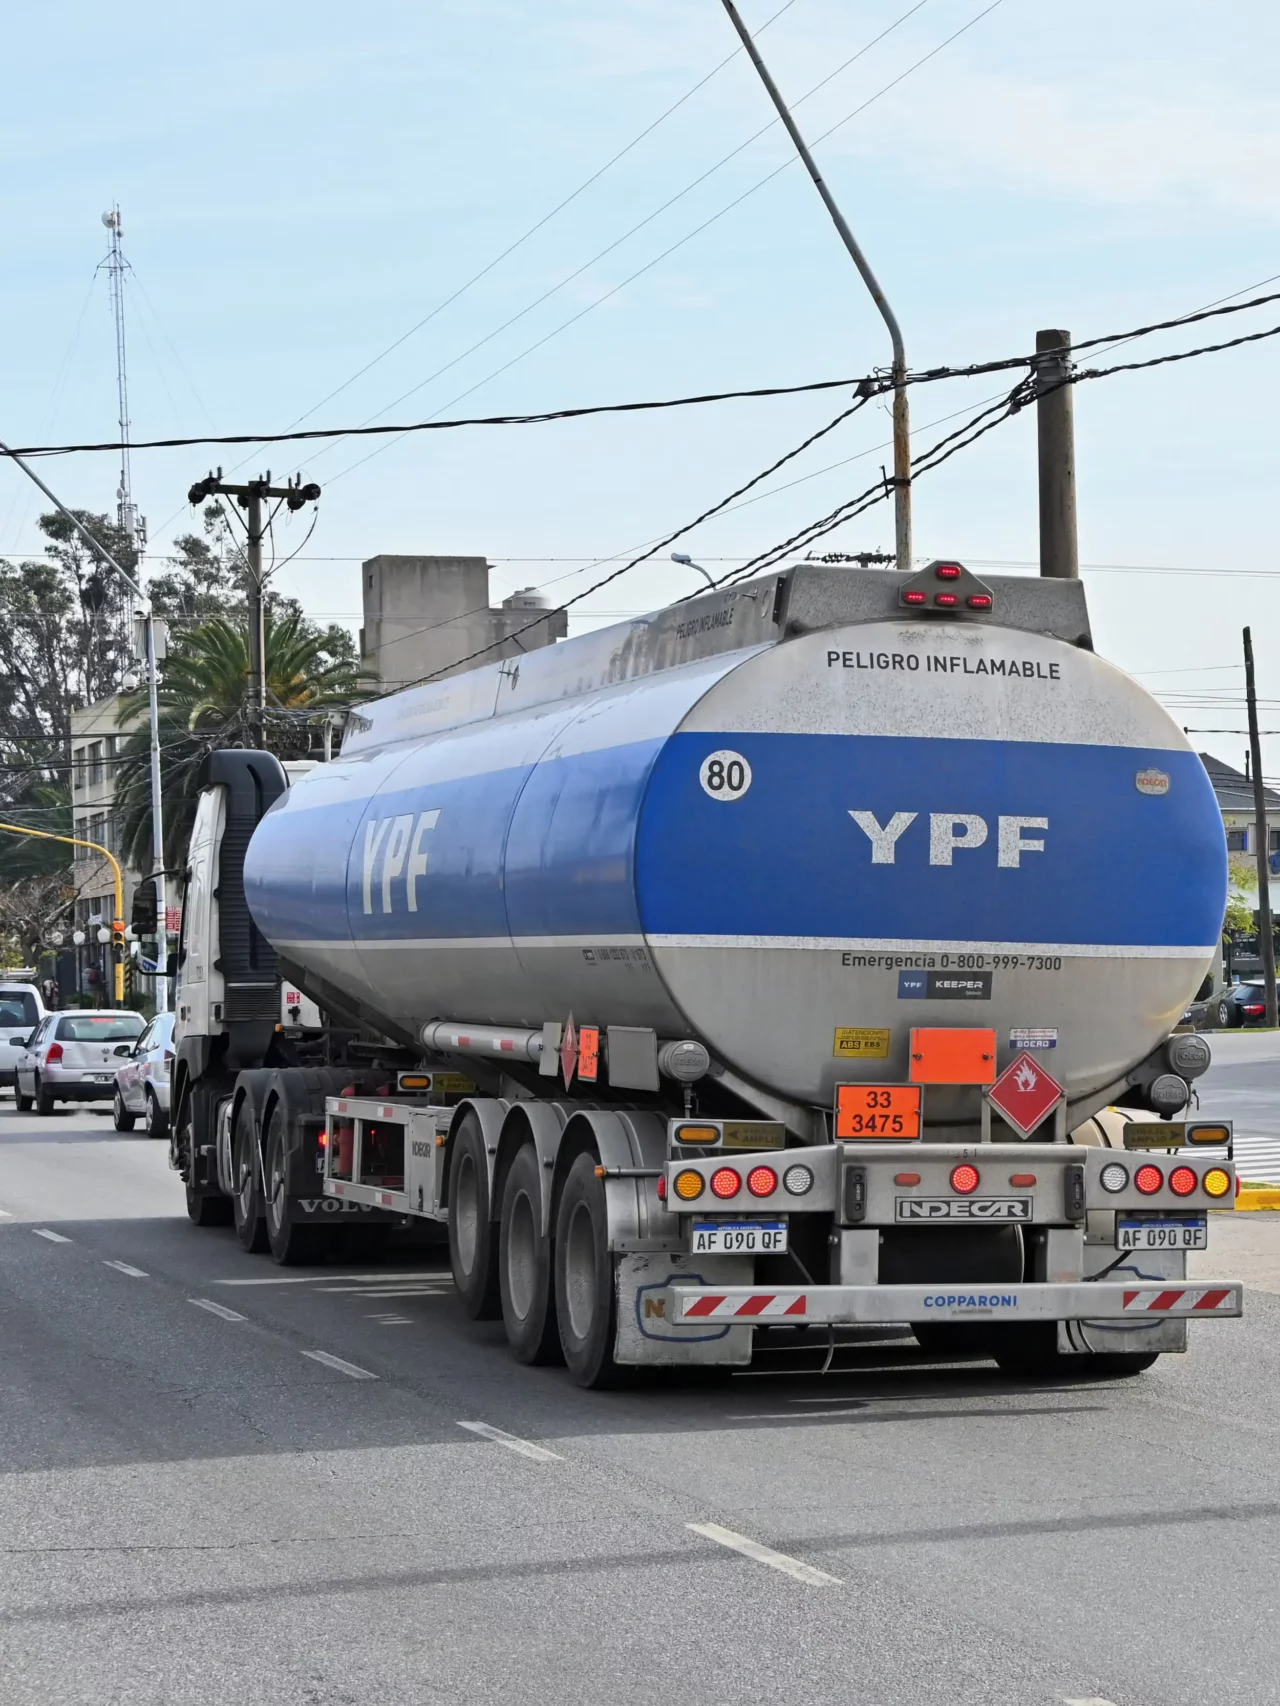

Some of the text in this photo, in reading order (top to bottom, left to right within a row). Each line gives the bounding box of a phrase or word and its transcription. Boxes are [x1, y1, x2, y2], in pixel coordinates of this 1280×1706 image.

[827, 651, 1061, 680] PELIGRO INFLAMABLE
[707, 760, 745, 791] 80
[847, 810, 1049, 868] YPF
[363, 808, 442, 914] YPF
[841, 953, 1062, 970] Emergencia 0-800-999-7300
[935, 980, 984, 989] KEEPER
[840, 1041, 860, 1049] ABS
[866, 1091, 892, 1108] 33
[852, 1114, 904, 1132] 3475
[298, 1199, 390, 1213] VOLV
[901, 1200, 1025, 1218] INDECAR
[697, 1231, 782, 1250] AF 090 QF
[1122, 1229, 1202, 1247] AF 090 QF
[923, 1295, 1017, 1307] COPPARONI
